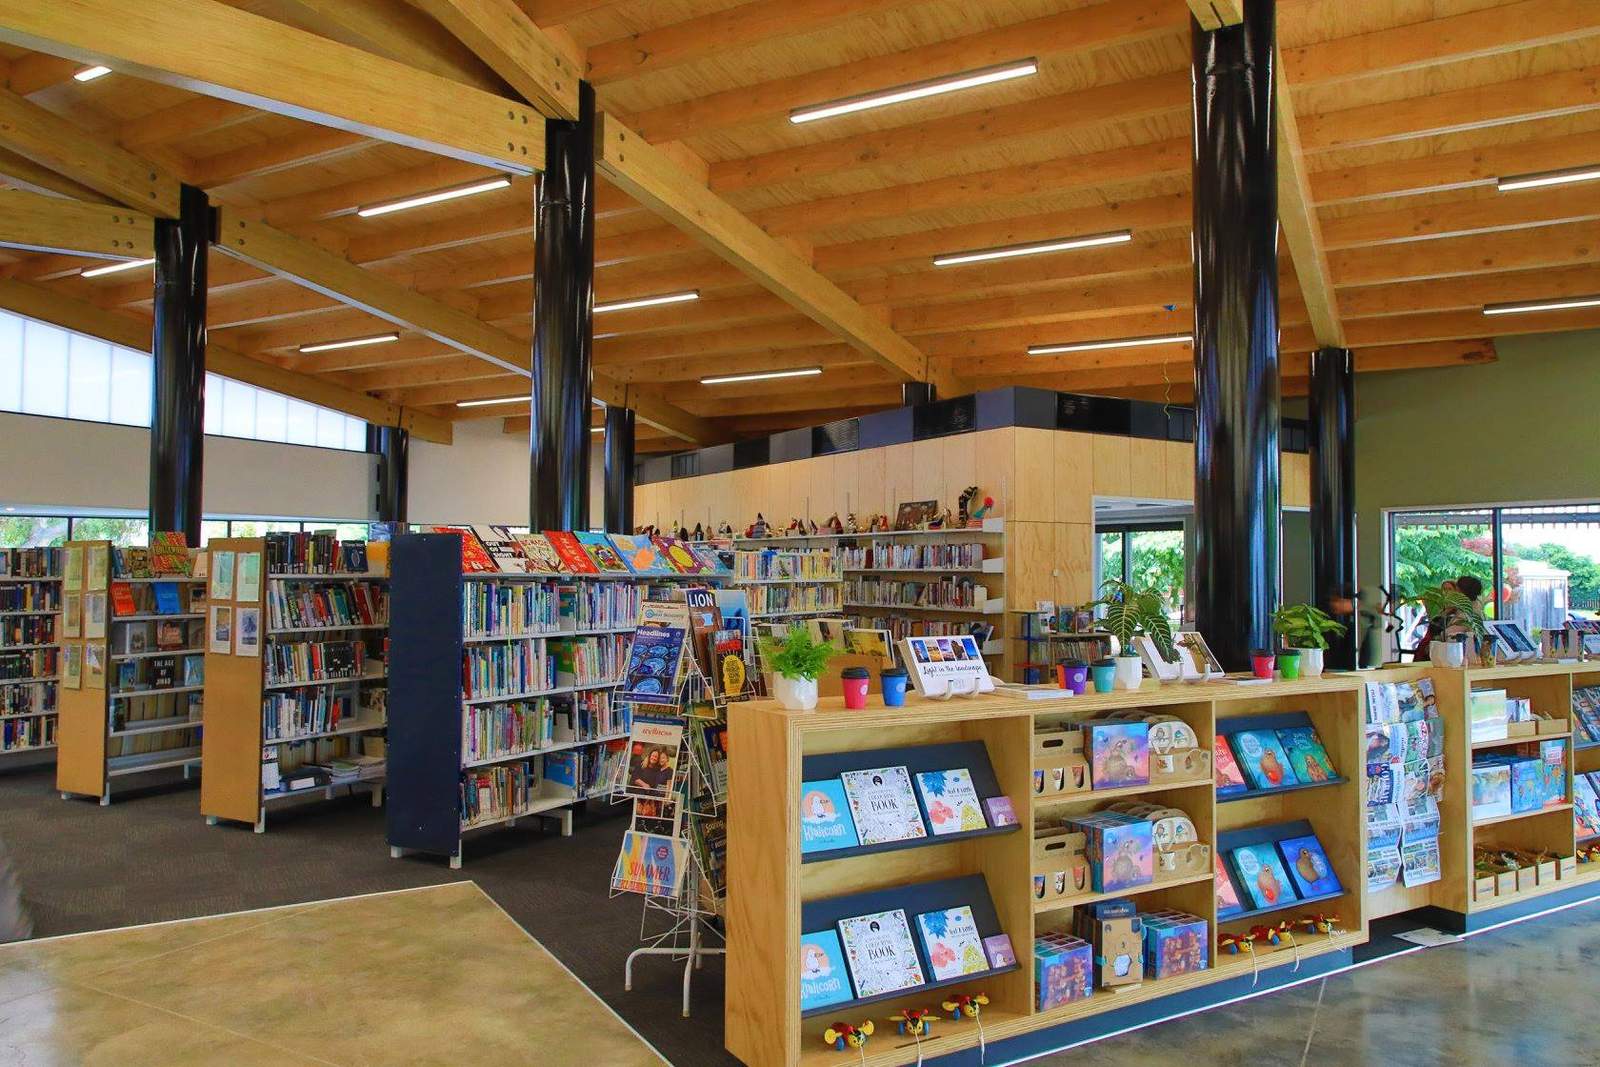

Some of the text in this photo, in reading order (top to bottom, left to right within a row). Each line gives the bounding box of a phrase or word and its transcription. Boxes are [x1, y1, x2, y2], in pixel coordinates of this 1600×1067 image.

[688, 593, 714, 608] LION
[636, 628, 670, 638] Headlines
[870, 798, 899, 812] BOOK
[867, 944, 896, 960] BOOK
